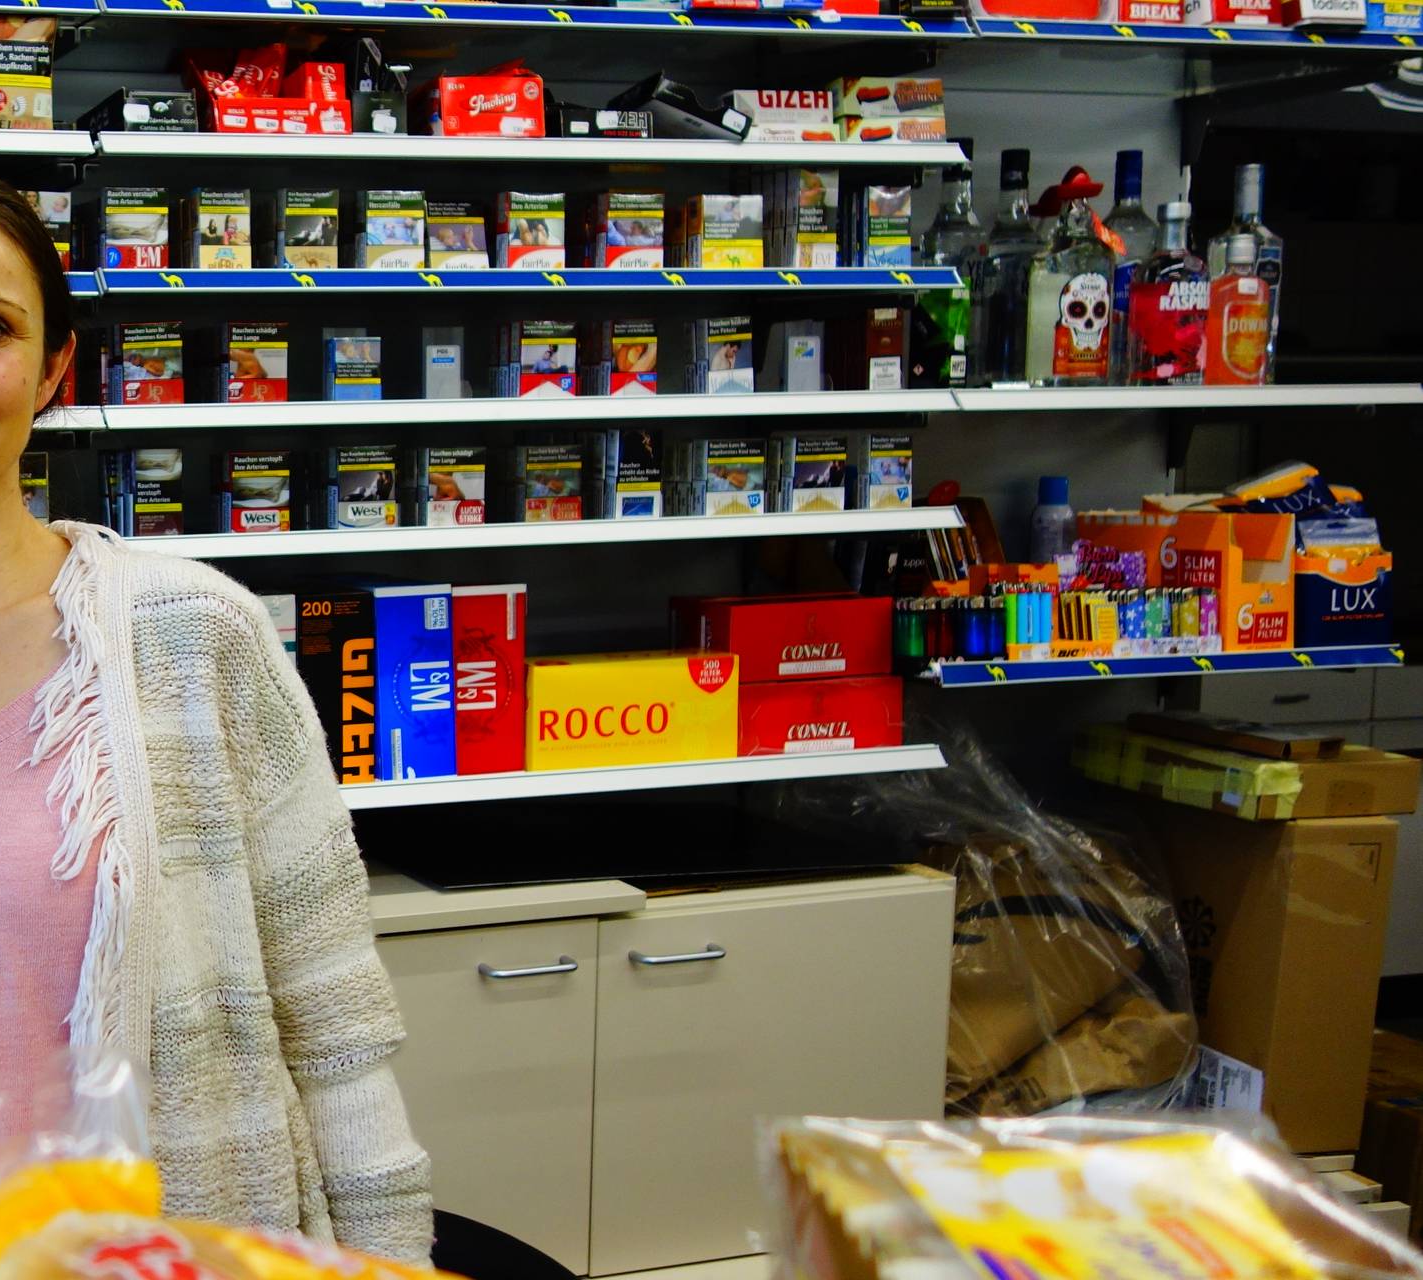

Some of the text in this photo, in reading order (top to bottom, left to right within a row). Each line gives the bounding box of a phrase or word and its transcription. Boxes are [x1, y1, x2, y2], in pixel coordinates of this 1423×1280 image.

[1130, 4, 1180, 20] BREAK
[469, 91, 517, 116] Smoking
[244, 512, 276, 524] West
[351, 506, 382, 516] West
[459, 515, 482, 523] STRIKE
[460, 507, 482, 515] LUCKY
[1160, 537, 1177, 570] 6
[1184, 556, 1215, 570] SLIM
[1183, 572, 1215, 583] FILTER
[1330, 588, 1377, 612] LUX
[302, 601, 332, 616] 200
[1237, 603, 1254, 631] 6
[1259, 616, 1284, 629] SLIM
[1257, 628, 1283, 638] FILTER
[781, 642, 843, 661] CONSUL
[702, 660, 720, 670] 500
[409, 660, 451, 712] L&M
[456, 660, 497, 711] L&M
[342, 637, 375, 784] GIZEH
[538, 702, 670, 742] ROCCO
[788, 721, 851, 739] CONSUL
